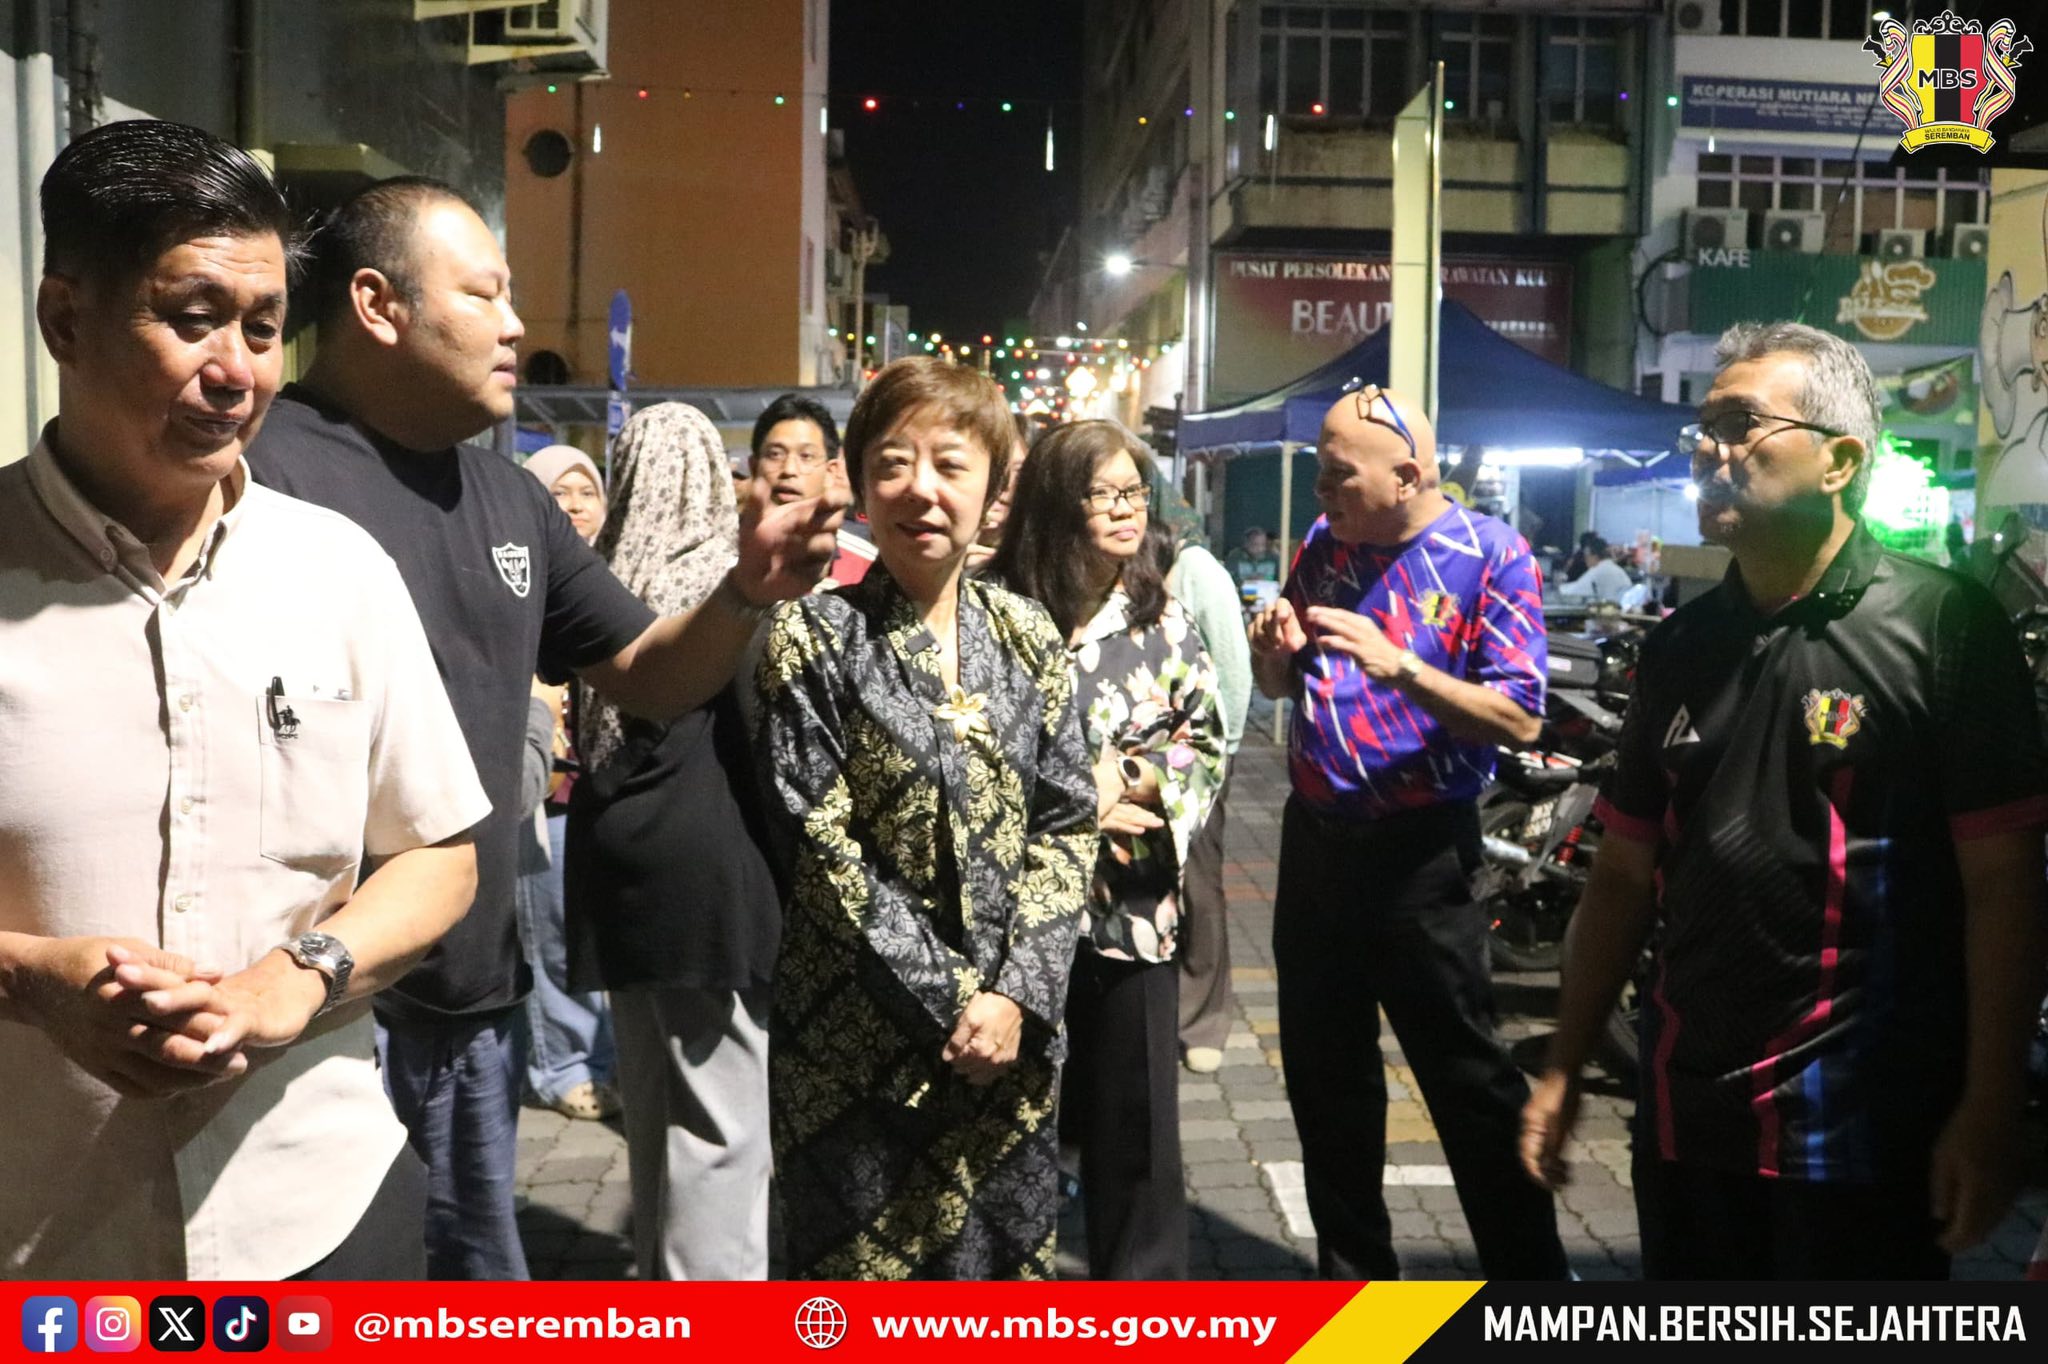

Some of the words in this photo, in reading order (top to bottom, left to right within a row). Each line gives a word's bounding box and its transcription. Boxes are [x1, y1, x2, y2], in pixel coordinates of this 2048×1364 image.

[1692, 84, 1773, 101] KOPERASI
[1778, 88, 1850, 105] MUTIARA
[1699, 247, 1751, 268] KAFE
[1230, 260, 1279, 278] PUSAT
[1283, 261, 1392, 281] PERSOLEKAN
